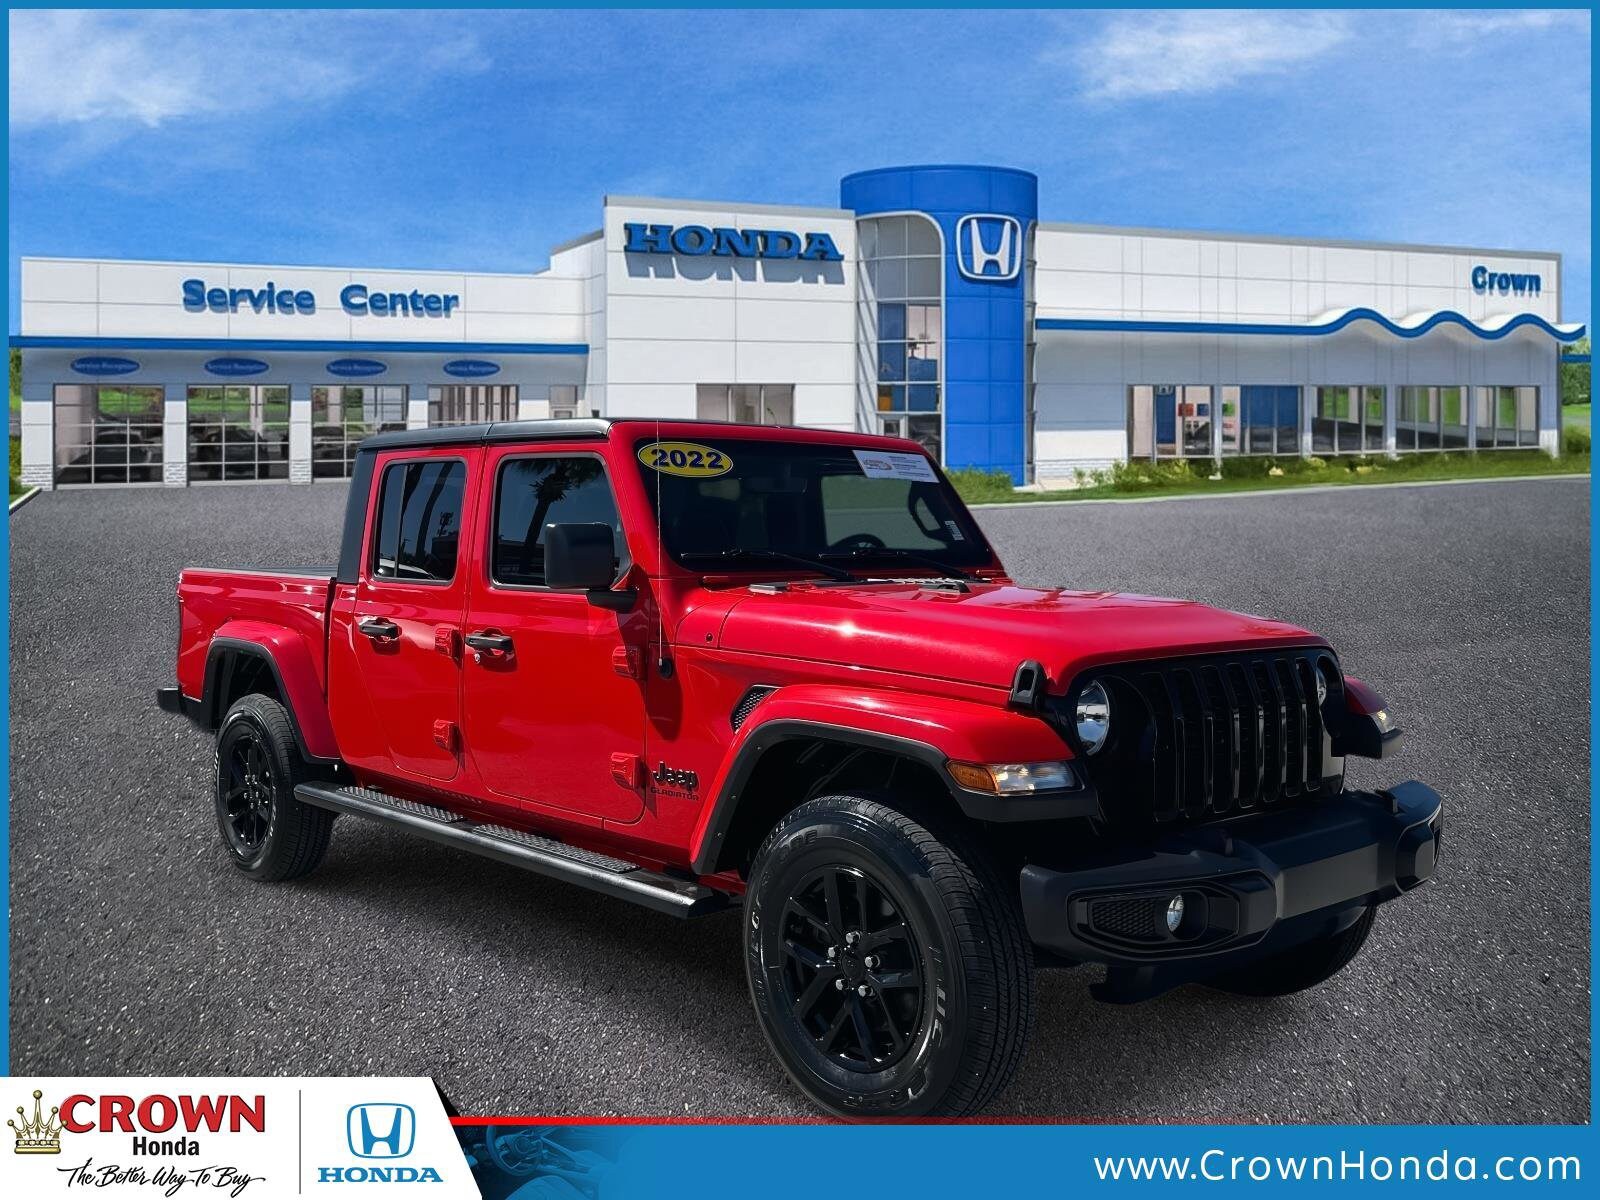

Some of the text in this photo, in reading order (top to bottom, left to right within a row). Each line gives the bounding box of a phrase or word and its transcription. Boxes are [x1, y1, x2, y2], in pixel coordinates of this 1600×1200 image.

[623, 222, 845, 261] HONDA
[1471, 265, 1541, 292] Crown
[182, 279, 459, 313] Service Center
[650, 448, 725, 470] 2022
[652, 761, 700, 791] Jeep
[651, 786, 699, 801] GLADIATOR
